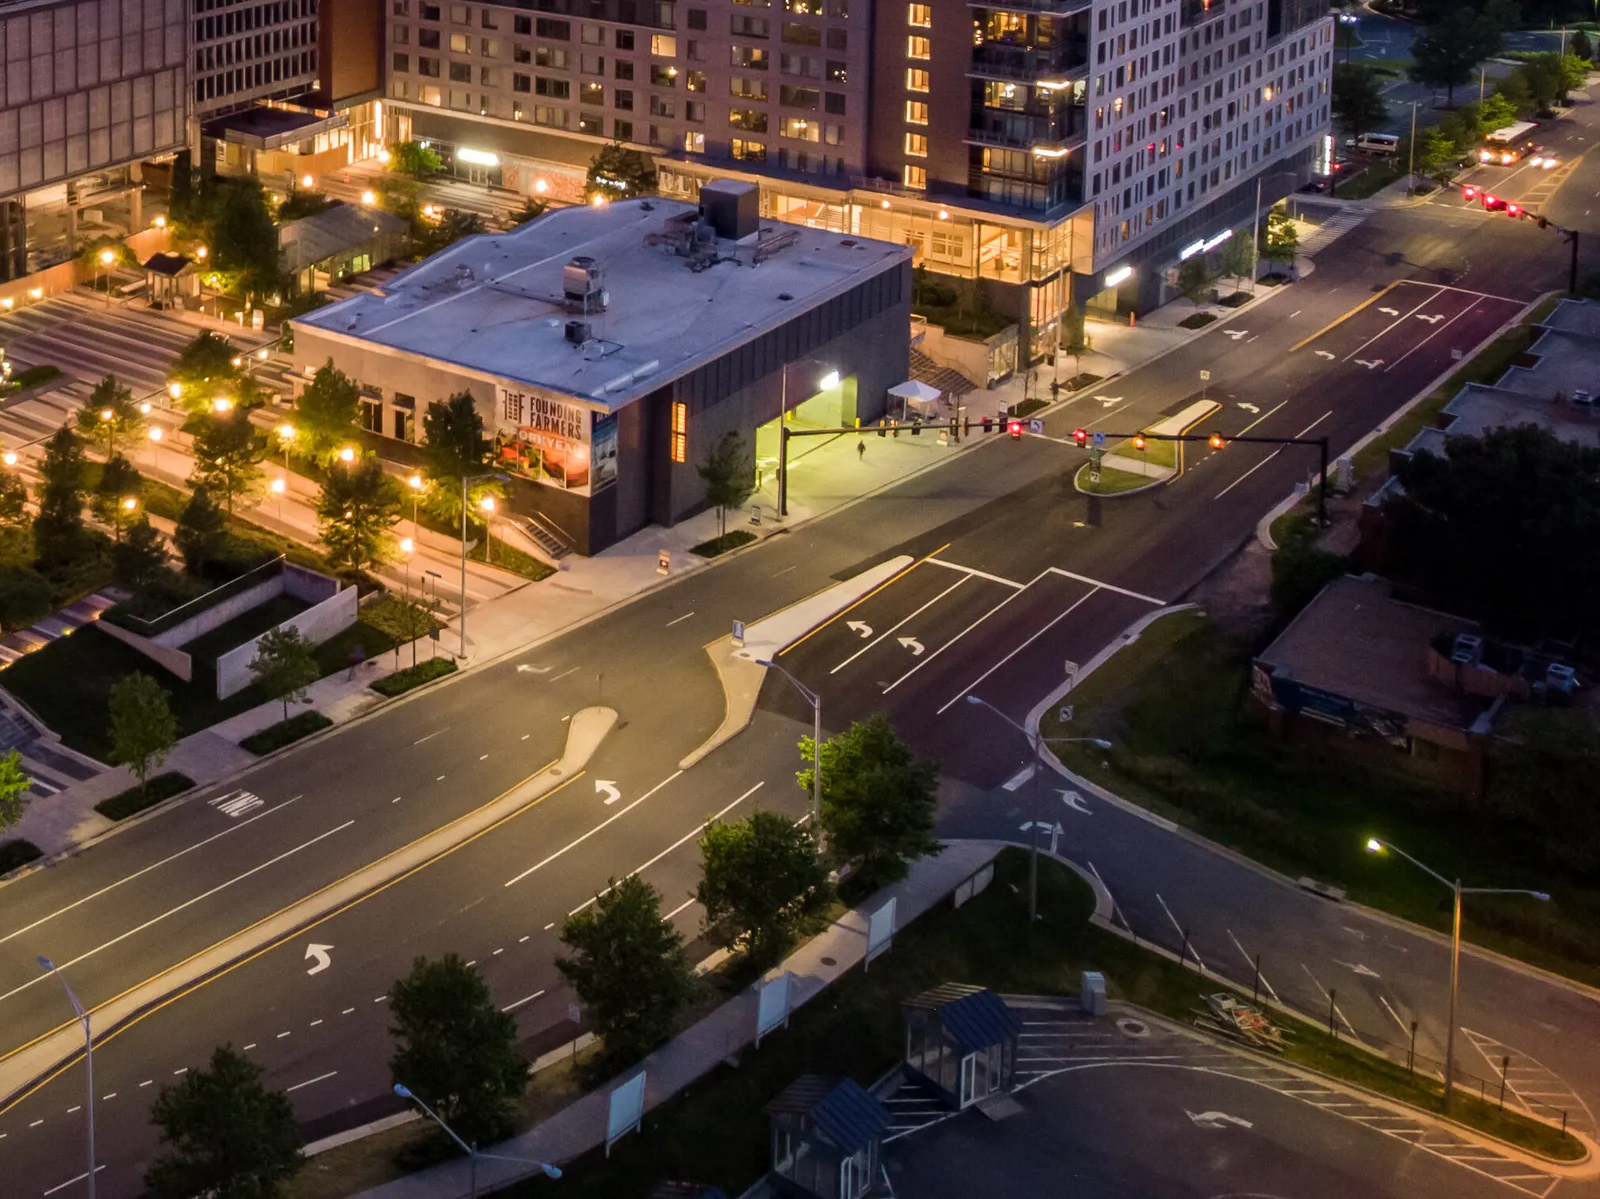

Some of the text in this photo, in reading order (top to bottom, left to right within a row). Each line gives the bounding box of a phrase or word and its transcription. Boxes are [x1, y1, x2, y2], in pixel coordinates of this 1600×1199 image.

[530, 396, 582, 424] FOUNDING
[530, 411, 582, 440] FARMERS
[207, 788, 266, 818] ONLY
